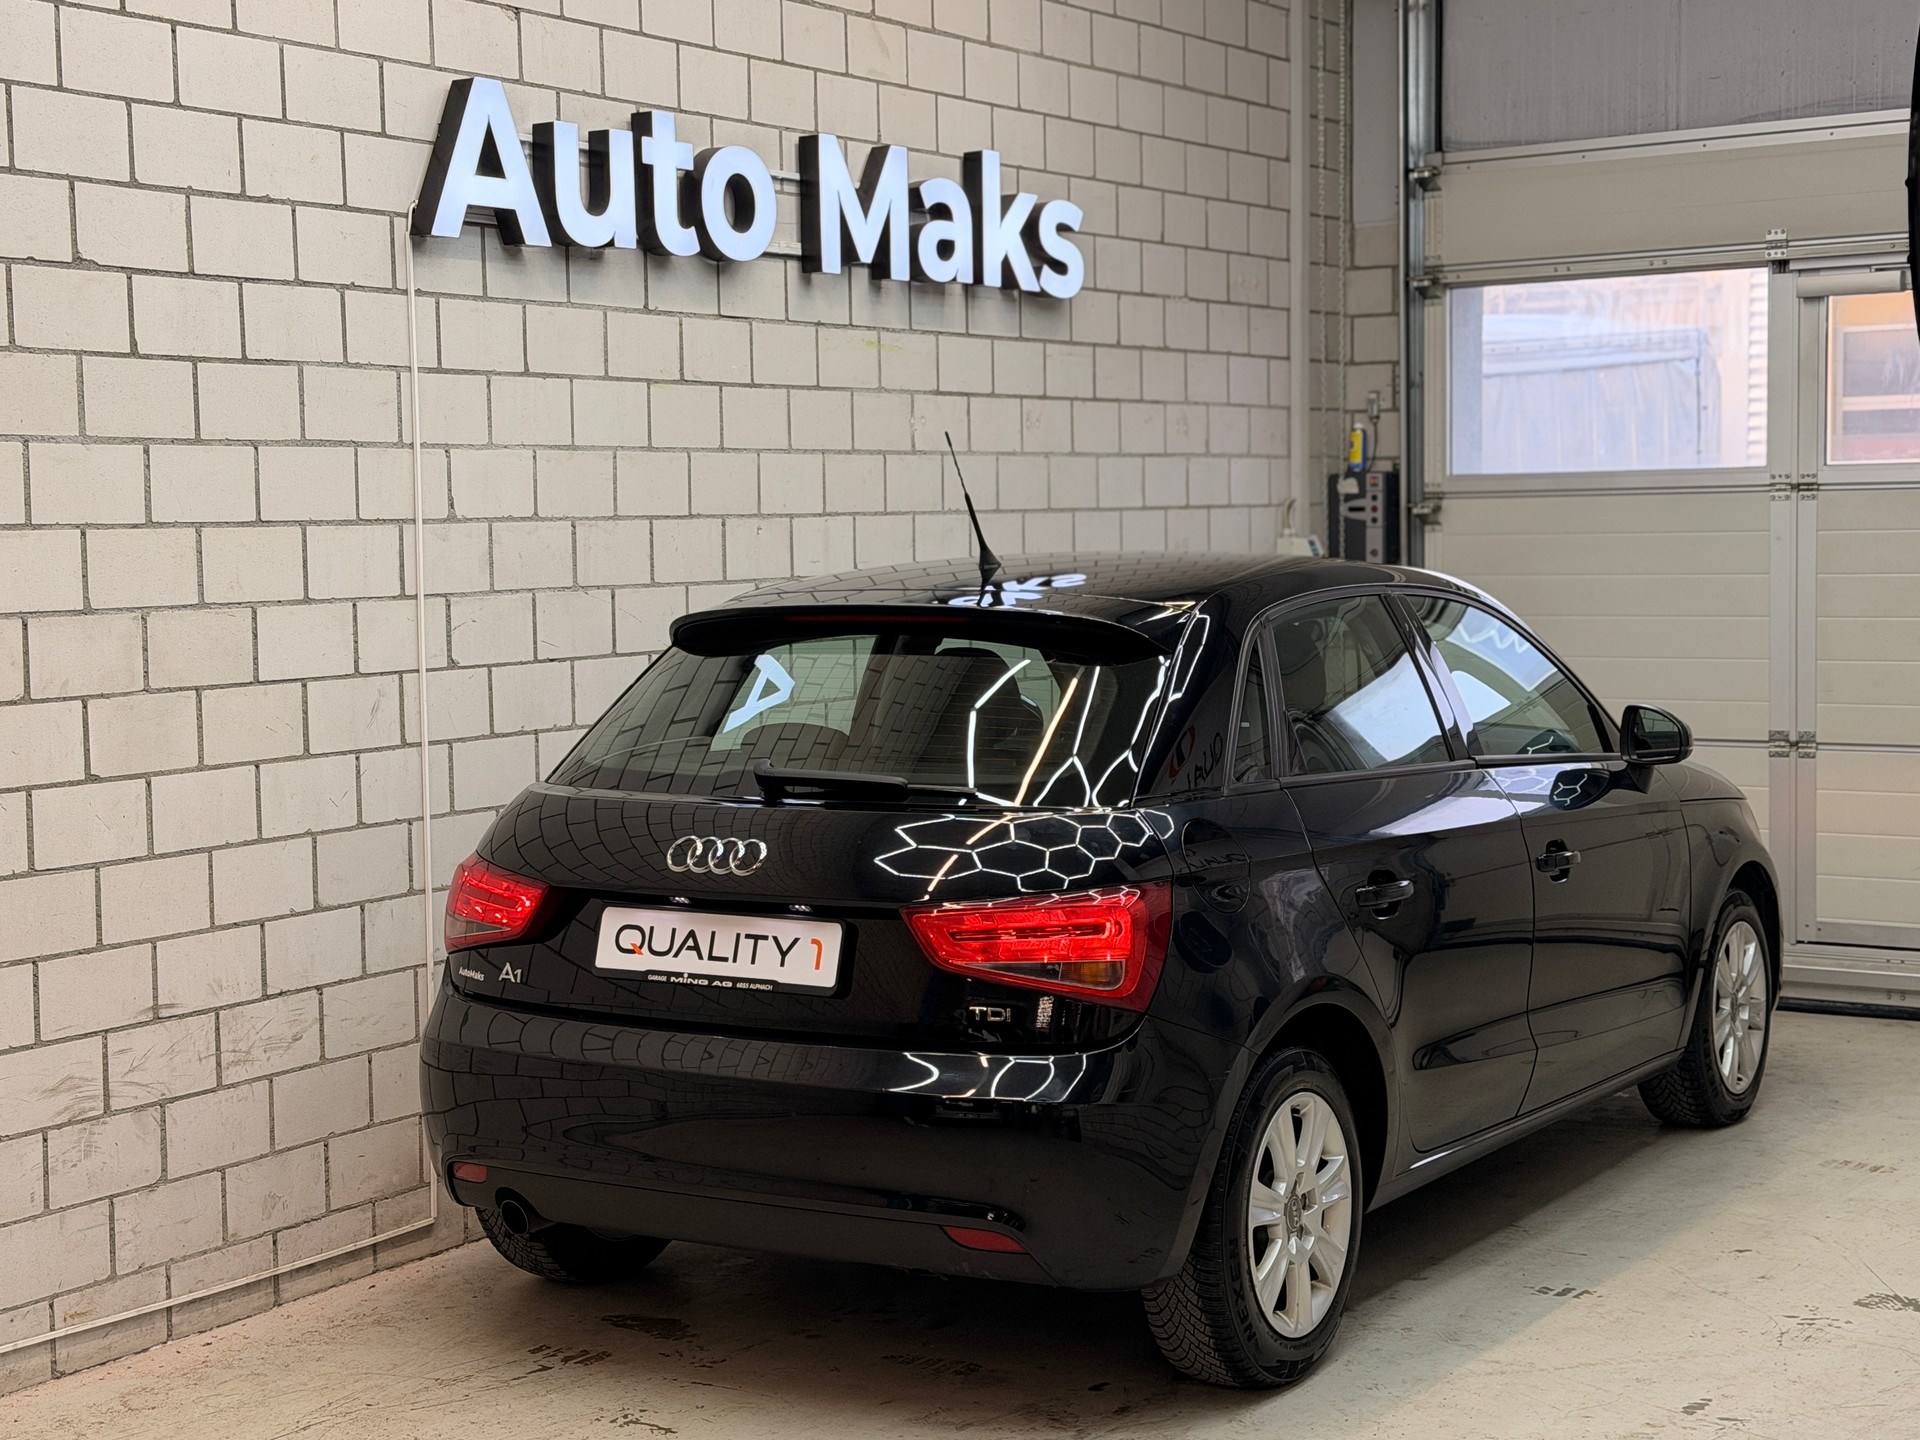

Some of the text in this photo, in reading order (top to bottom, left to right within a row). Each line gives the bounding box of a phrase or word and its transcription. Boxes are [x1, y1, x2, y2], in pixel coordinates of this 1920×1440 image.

[412, 76, 1086, 299] Auto Maks
[614, 924, 823, 970] QUALITY 1
[498, 962, 522, 983] A1
[647, 974, 667, 982] GARAGE
[711, 980, 733, 988] AG
[969, 1006, 1012, 1022] TDI
